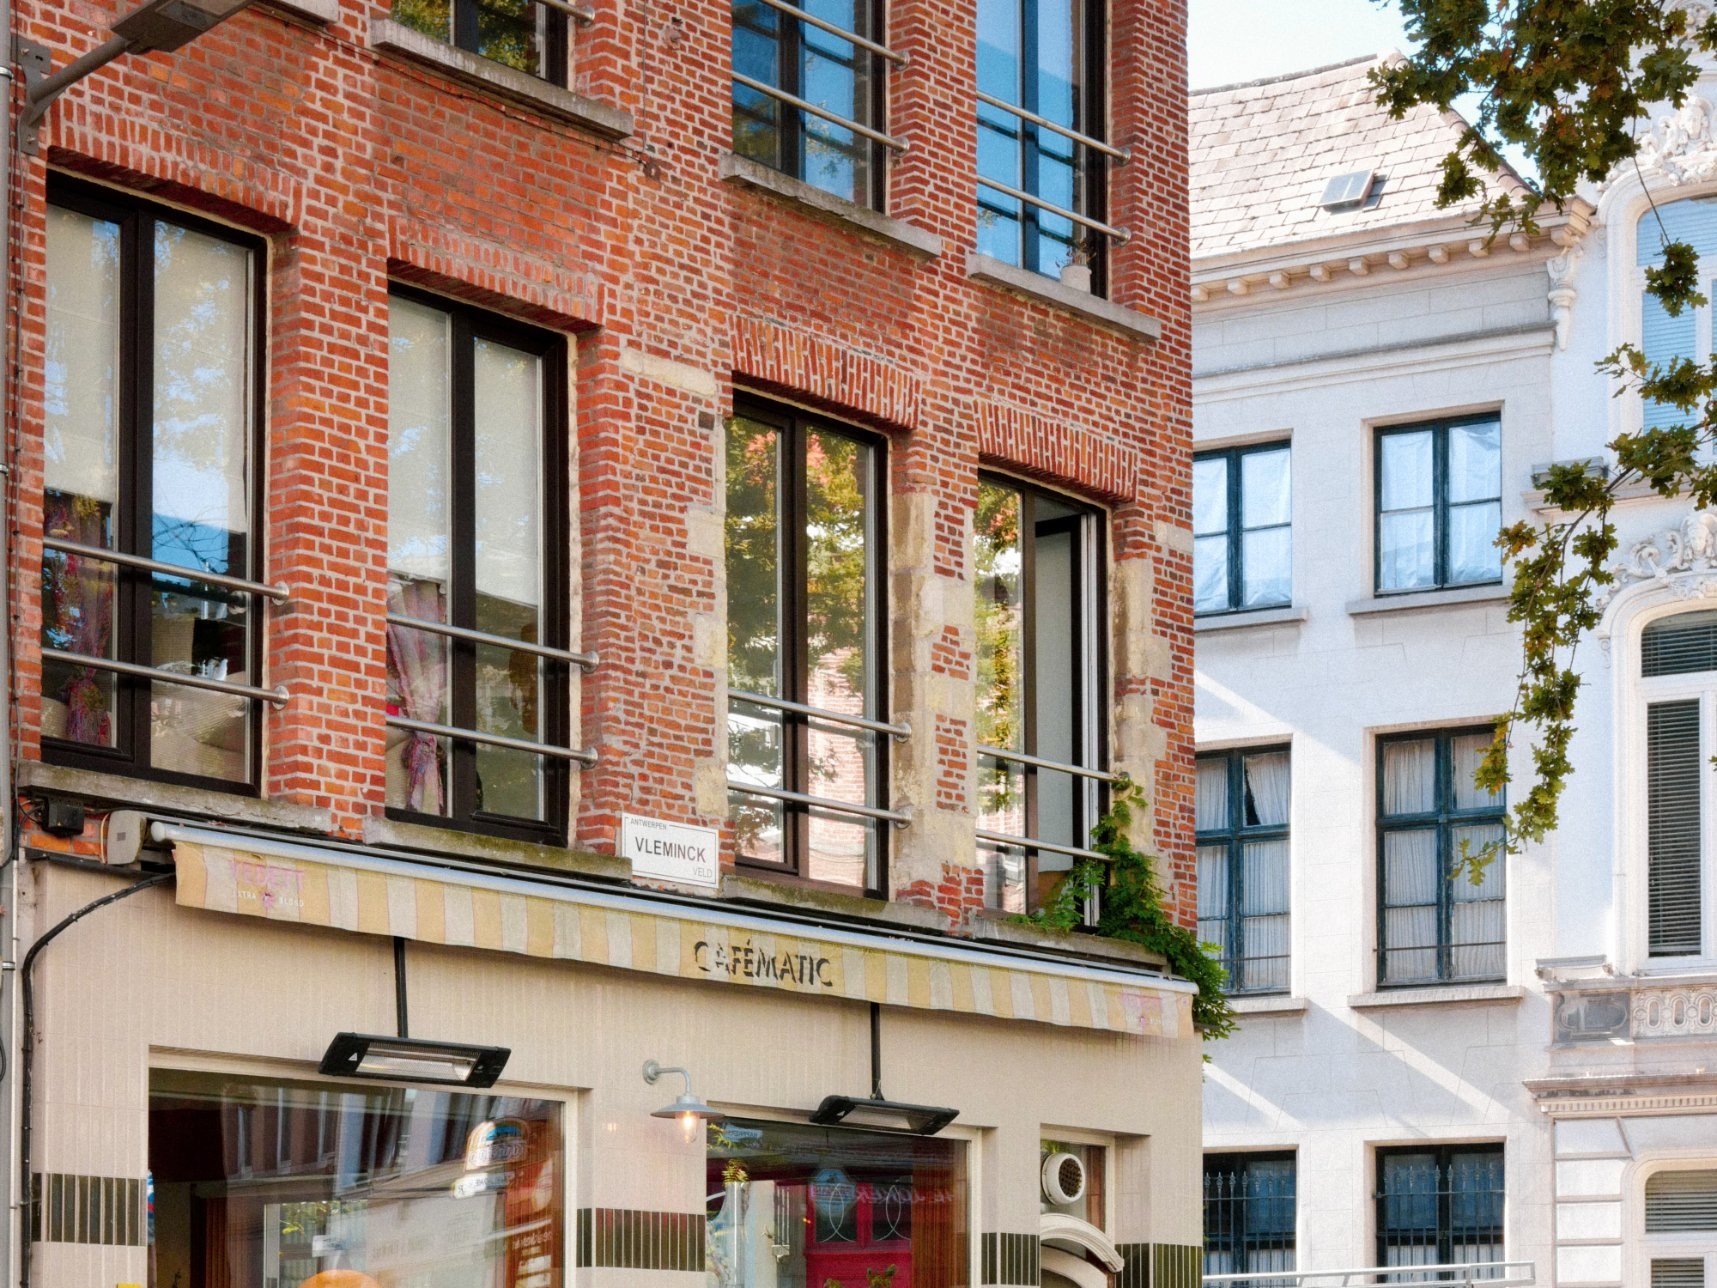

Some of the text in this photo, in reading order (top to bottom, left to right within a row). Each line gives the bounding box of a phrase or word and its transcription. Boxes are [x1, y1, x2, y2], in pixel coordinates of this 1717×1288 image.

[631, 818, 667, 830] ANTWERPEN
[635, 836, 706, 863] VLEMINCK
[693, 867, 713, 878] VELD
[694, 938, 833, 988] CAFÉMATIC
